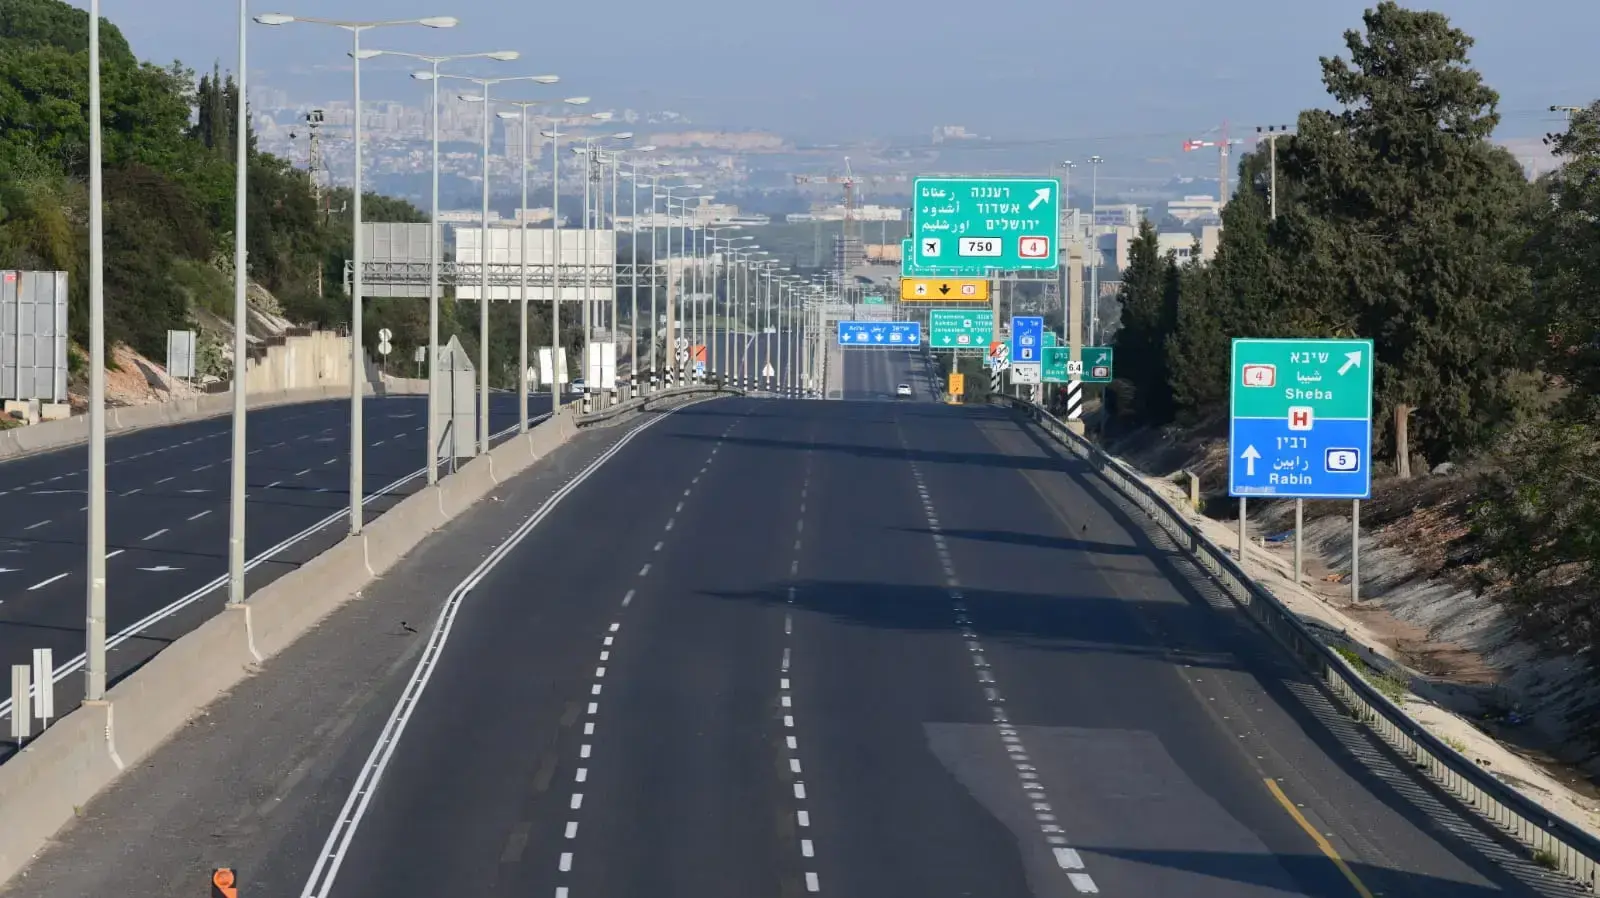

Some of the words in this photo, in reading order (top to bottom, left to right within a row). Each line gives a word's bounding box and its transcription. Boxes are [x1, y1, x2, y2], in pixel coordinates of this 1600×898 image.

[922, 187, 955, 201] رعنانا
[971, 187, 1010, 198] רעננה
[922, 200, 960, 217] أشدود
[976, 203, 1020, 214] אשדוד
[985, 218, 1040, 231] ירושלים
[968, 242, 993, 252] 750
[1030, 242, 1037, 253] 4
[1290, 351, 1329, 364] שיבא
[1068, 363, 1082, 372] 6.4
[1255, 371, 1263, 381] 4
[1296, 369, 1322, 385] شيبا
[1285, 387, 1333, 400] Sheba
[1293, 411, 1308, 426] H
[1276, 436, 1307, 450] רבין
[1273, 455, 1309, 471] رابين
[1338, 454, 1346, 466] 5
[1269, 473, 1313, 485] Rabin
